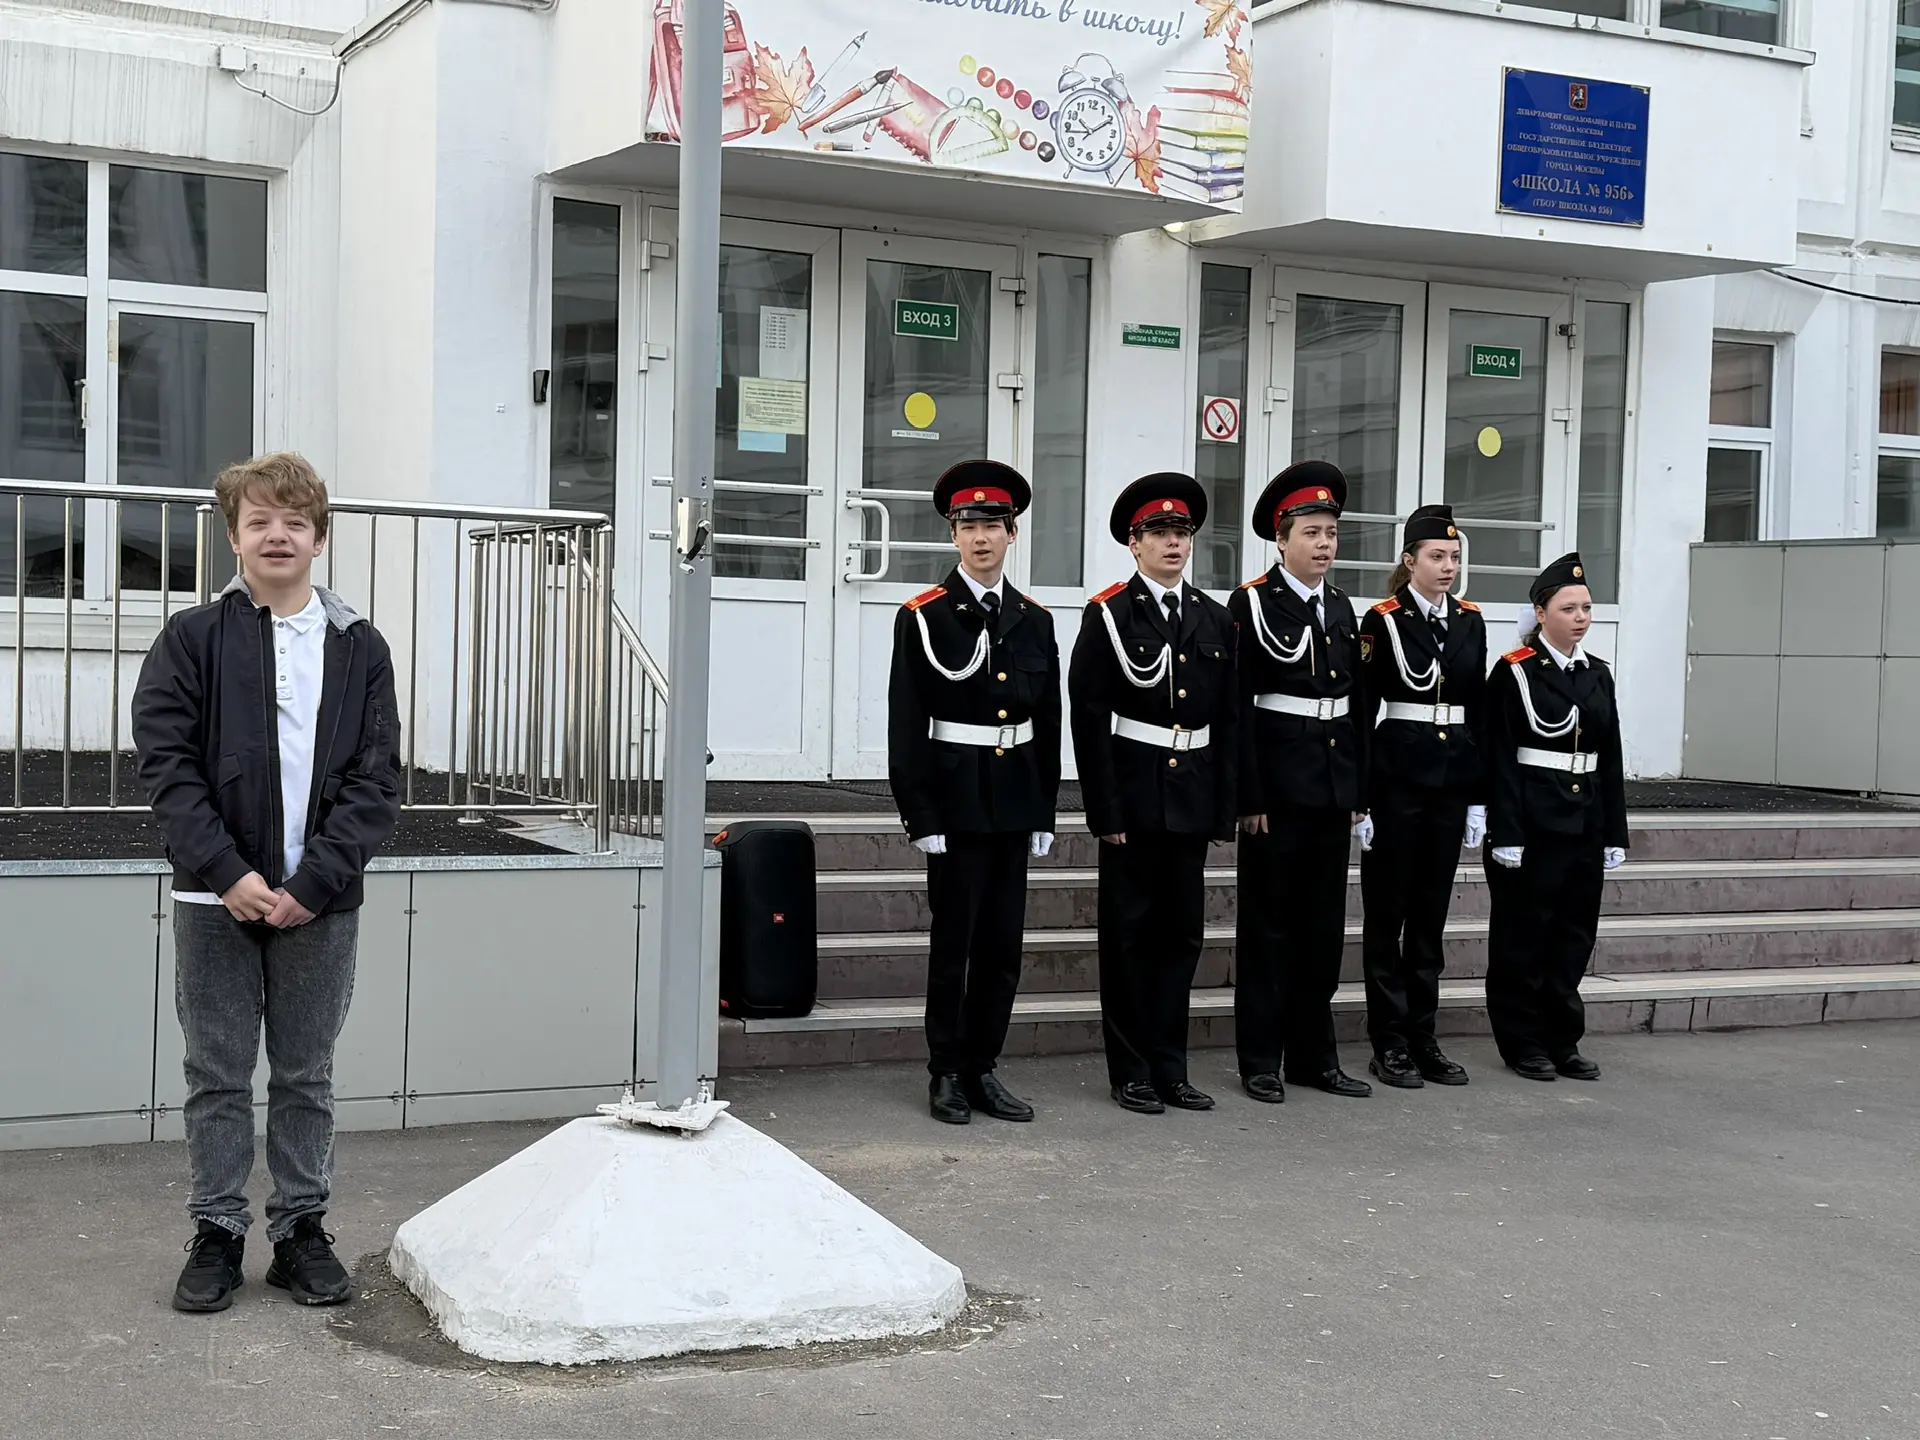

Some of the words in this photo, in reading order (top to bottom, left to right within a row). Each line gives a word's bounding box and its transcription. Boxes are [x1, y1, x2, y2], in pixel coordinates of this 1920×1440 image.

[1082, 9, 1186, 45] школу!
[1076, 102, 1085, 112] 11
[1088, 99, 1099, 110] 12
[1101, 105, 1106, 115] 1
[1067, 110, 1079, 121] 10
[1109, 129, 1117, 139] 3
[1550, 122, 1575, 133] ГОРОДА
[1576, 127, 1604, 137] МОСКВЫ
[1067, 136, 1076, 148] 8
[1106, 141, 1113, 152] 4
[1519, 132, 1587, 147] ГОСУДАРСТВЕННОЕ
[1588, 141, 1633, 153] БЮДЖЕТНОЕ
[1077, 147, 1084, 157] 7
[1086, 151, 1094, 162] 6
[1099, 149, 1105, 160] 5
[1545, 161, 1573, 172] ГОРОДА
[1574, 164, 1605, 175] МОСКВЫ
[1512, 173, 1582, 196] «ШКОЛА
[1585, 183, 1601, 197] №
[1604, 183, 1635, 201] 956»
[1533, 198, 1558, 209] (ГБОУ
[1558, 201, 1588, 213] ШКОЛА
[903, 310, 941, 328] ВХОД
[944, 314, 951, 327] 3
[1477, 354, 1507, 368] ВХОД
[1509, 357, 1516, 367] 4
